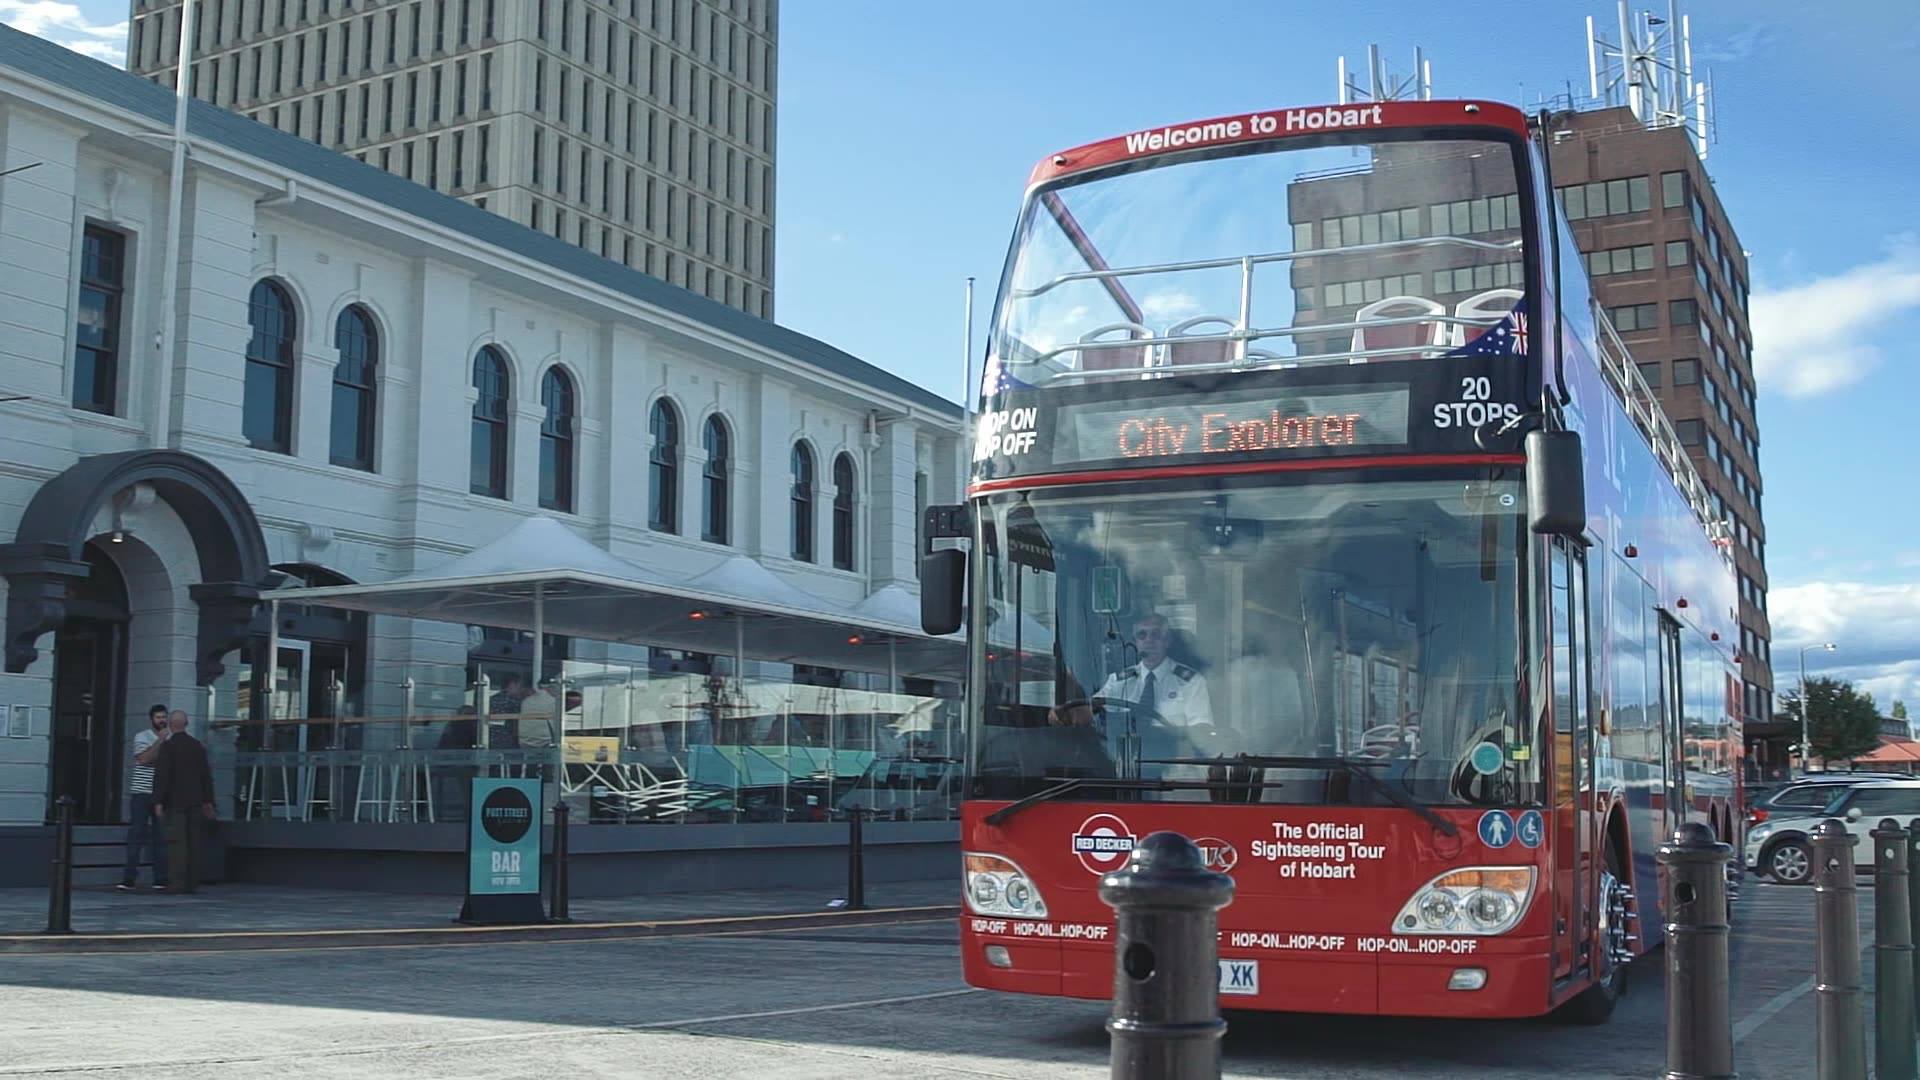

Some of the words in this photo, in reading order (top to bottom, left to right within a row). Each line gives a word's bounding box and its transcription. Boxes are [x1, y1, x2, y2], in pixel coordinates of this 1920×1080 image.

[1126, 121, 1243, 154] Welcome
[1250, 114, 1277, 134] to
[1286, 105, 1382, 131] Hobart
[1461, 377, 1491, 400] 20
[1011, 407, 1038, 431] ON
[1433, 402, 1520, 429] STOPS
[1003, 431, 1038, 456] OFF
[1119, 416, 1190, 457] City
[1203, 409, 1361, 453] Explorer
[1272, 822, 1303, 839] The
[1306, 822, 1364, 840] Official
[1076, 837, 1095, 850] RED
[1095, 838, 1133, 851] DECKER
[1251, 840, 1346, 862] Sightseeing
[1348, 842, 1386, 859] Tour
[491, 850, 521, 873] BAR
[1280, 861, 1297, 878] of
[1300, 861, 1356, 879] Hobart
[1230, 964, 1254, 987] XK
